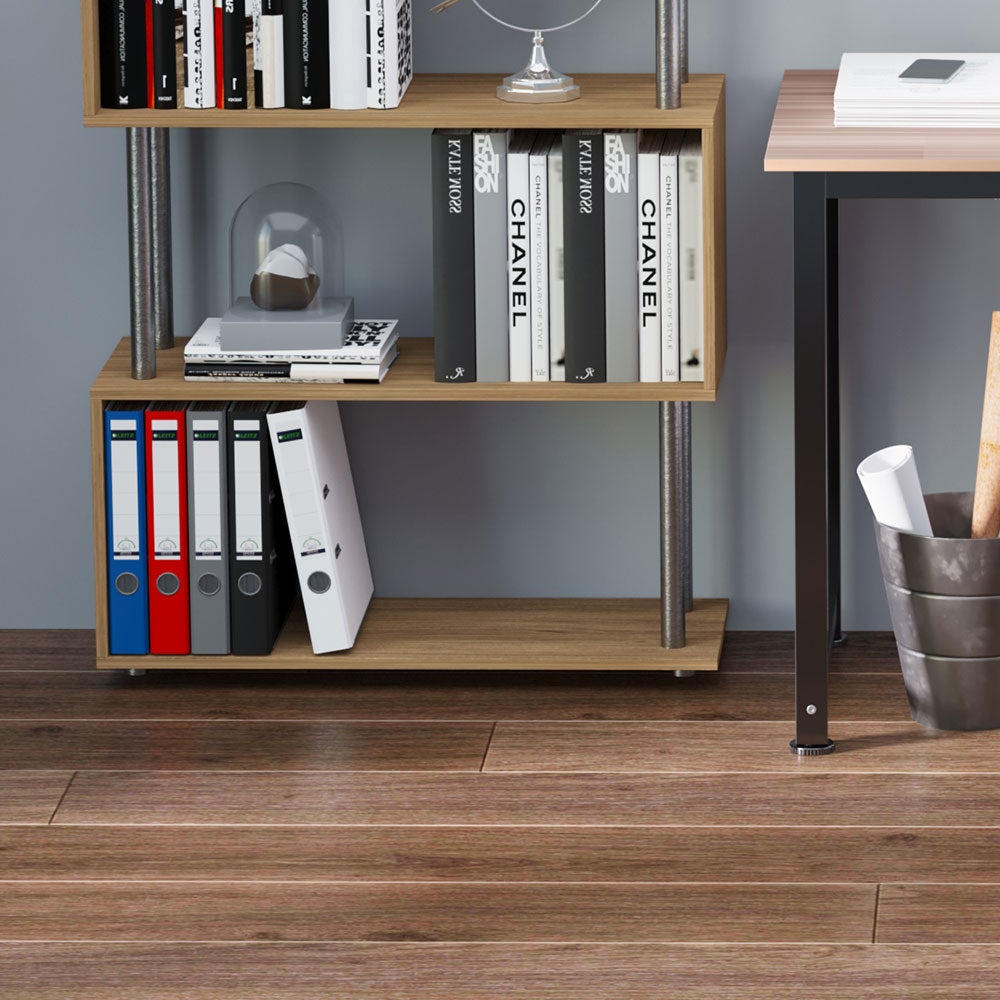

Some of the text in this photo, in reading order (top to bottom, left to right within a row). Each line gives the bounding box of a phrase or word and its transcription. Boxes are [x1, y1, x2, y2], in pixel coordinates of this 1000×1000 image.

[511, 199, 526, 327] CHANEL
[642, 199, 656, 327] CHANEL
[537, 307, 542, 319] OF
[666, 307, 672, 319] OF
